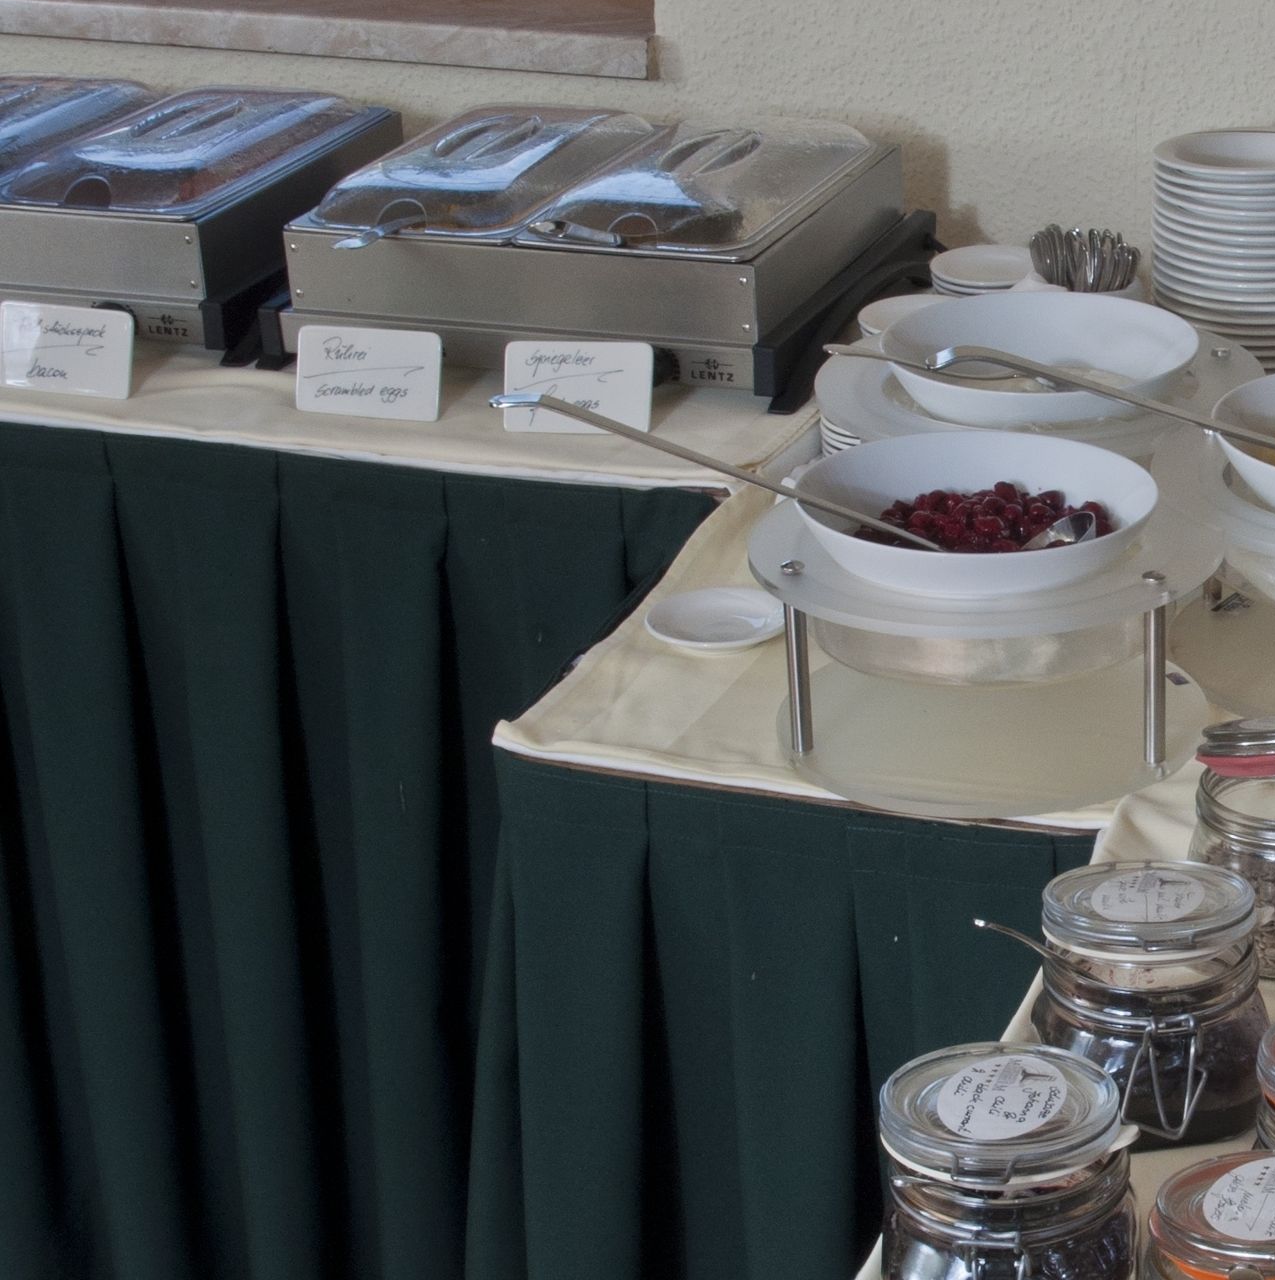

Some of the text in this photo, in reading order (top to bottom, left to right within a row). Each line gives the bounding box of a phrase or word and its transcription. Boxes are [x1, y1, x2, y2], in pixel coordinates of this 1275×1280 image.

[149, 325, 188, 337] LENTZ
[322, 336, 371, 361] Rührei
[26, 359, 68, 380] bacon
[691, 370, 734, 383] LENTZ
[380, 386, 408, 403] eggs
